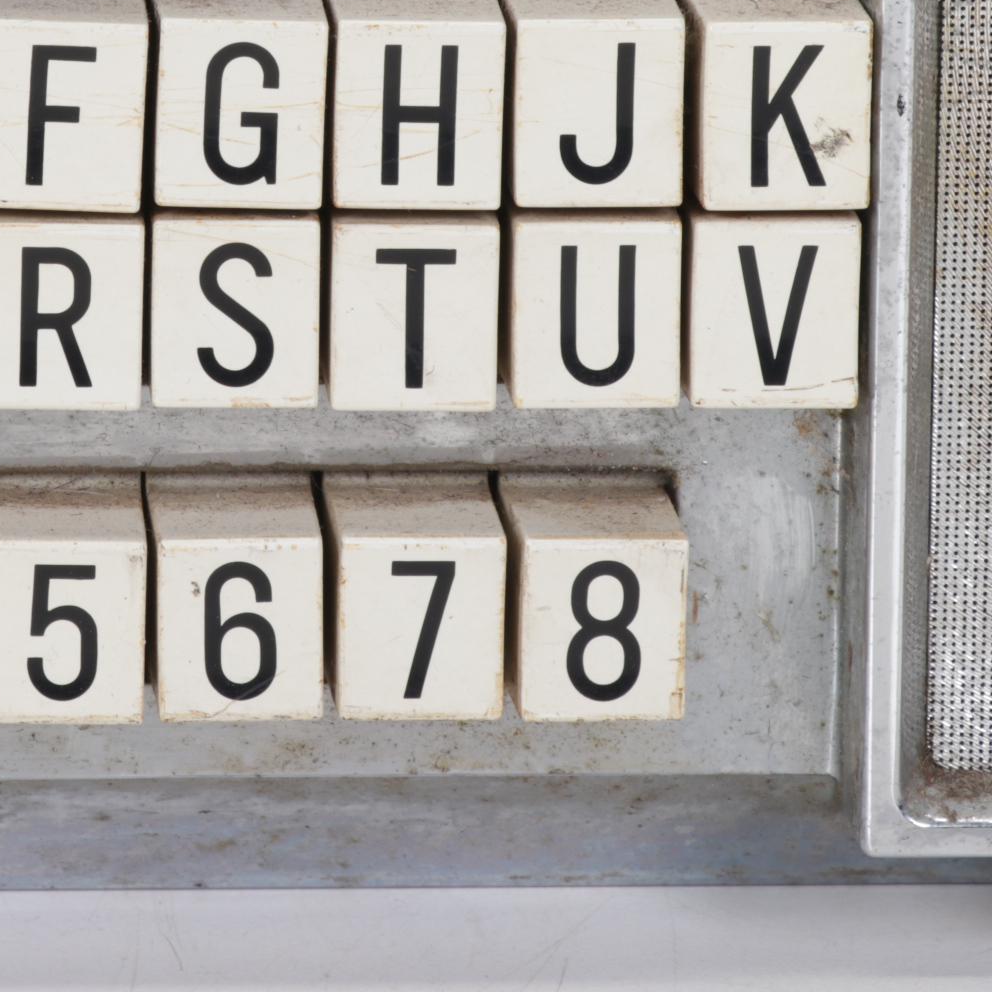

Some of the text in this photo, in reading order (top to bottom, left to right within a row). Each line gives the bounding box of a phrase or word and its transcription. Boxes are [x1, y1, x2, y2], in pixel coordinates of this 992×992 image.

[25, 44, 97, 186] F
[203, 42, 280, 186] G
[381, 44, 459, 186] H
[559, 42, 636, 185] J
[750, 44, 826, 188] K
[19, 246, 92, 388] R
[197, 242, 274, 388] S
[375, 248, 457, 389] T
[560, 244, 636, 387] U
[738, 245, 819, 386] V
[26, 564, 98, 702] 5
[204, 561, 277, 701] 6
[391, 560, 456, 699] 7
[566, 560, 641, 702] 8
